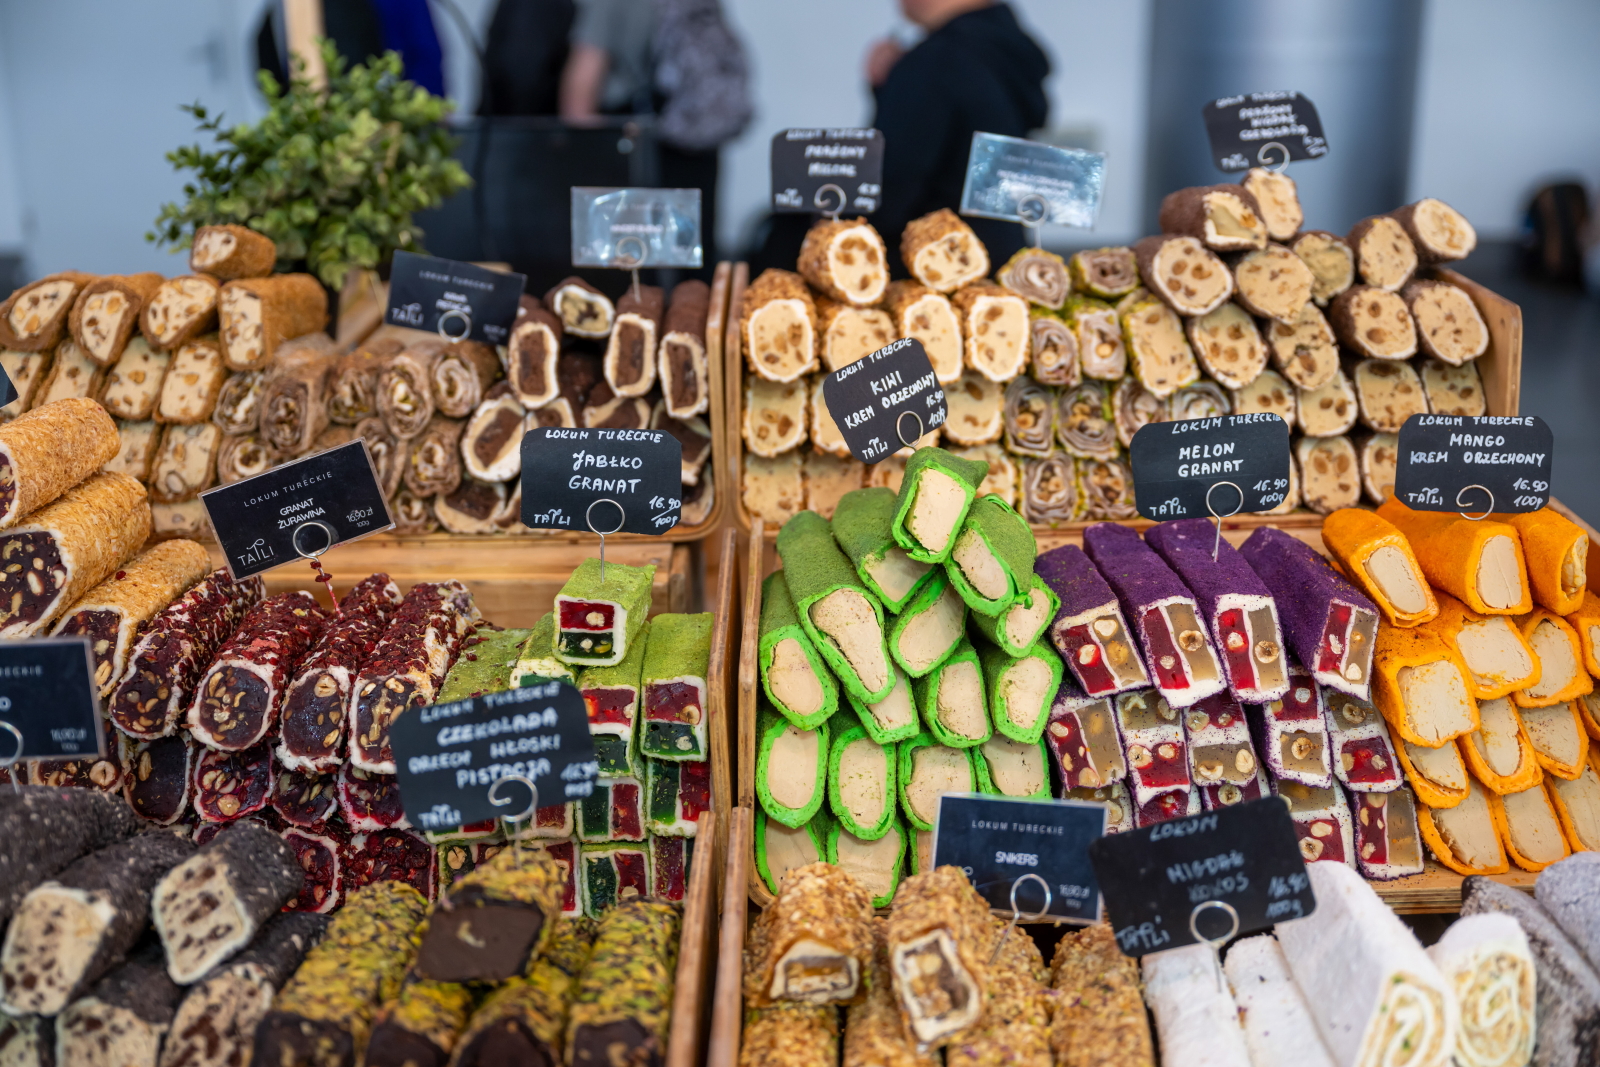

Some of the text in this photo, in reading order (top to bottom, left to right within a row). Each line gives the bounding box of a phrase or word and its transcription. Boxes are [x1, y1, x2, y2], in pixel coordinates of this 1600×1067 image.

[836, 360, 864, 382] LOKUM
[870, 370, 903, 395] KIWI
[844, 405, 876, 429] KREM
[1172, 417, 1222, 434] LOKUM
[1418, 416, 1463, 426] LOKUM
[545, 429, 663, 443] LOKUM TURECKIE
[1450, 433, 1505, 447] MANGO
[862, 437, 888, 459] TATLI
[1179, 442, 1235, 460] MELON
[572, 450, 643, 471] JABŁKO
[1410, 451, 1448, 465] KREM
[1178, 459, 1244, 478] GRANAT
[243, 471, 333, 507] LOKUM TURECKIE
[568, 475, 641, 494] GRANAT
[1408, 487, 1443, 505] TATLI
[279, 498, 314, 516] GRANAT
[1149, 497, 1187, 516] TATLI
[277, 507, 326, 530] ŻURAWINA
[534, 508, 571, 525] TATLI
[237, 538, 274, 566] TATLI
[437, 707, 559, 747] CZEKOLADA
[972, 820, 1064, 836] LOKUM TURECKIE
[1149, 814, 1219, 842] LOKUM
[995, 851, 1038, 867] SNIKERS
